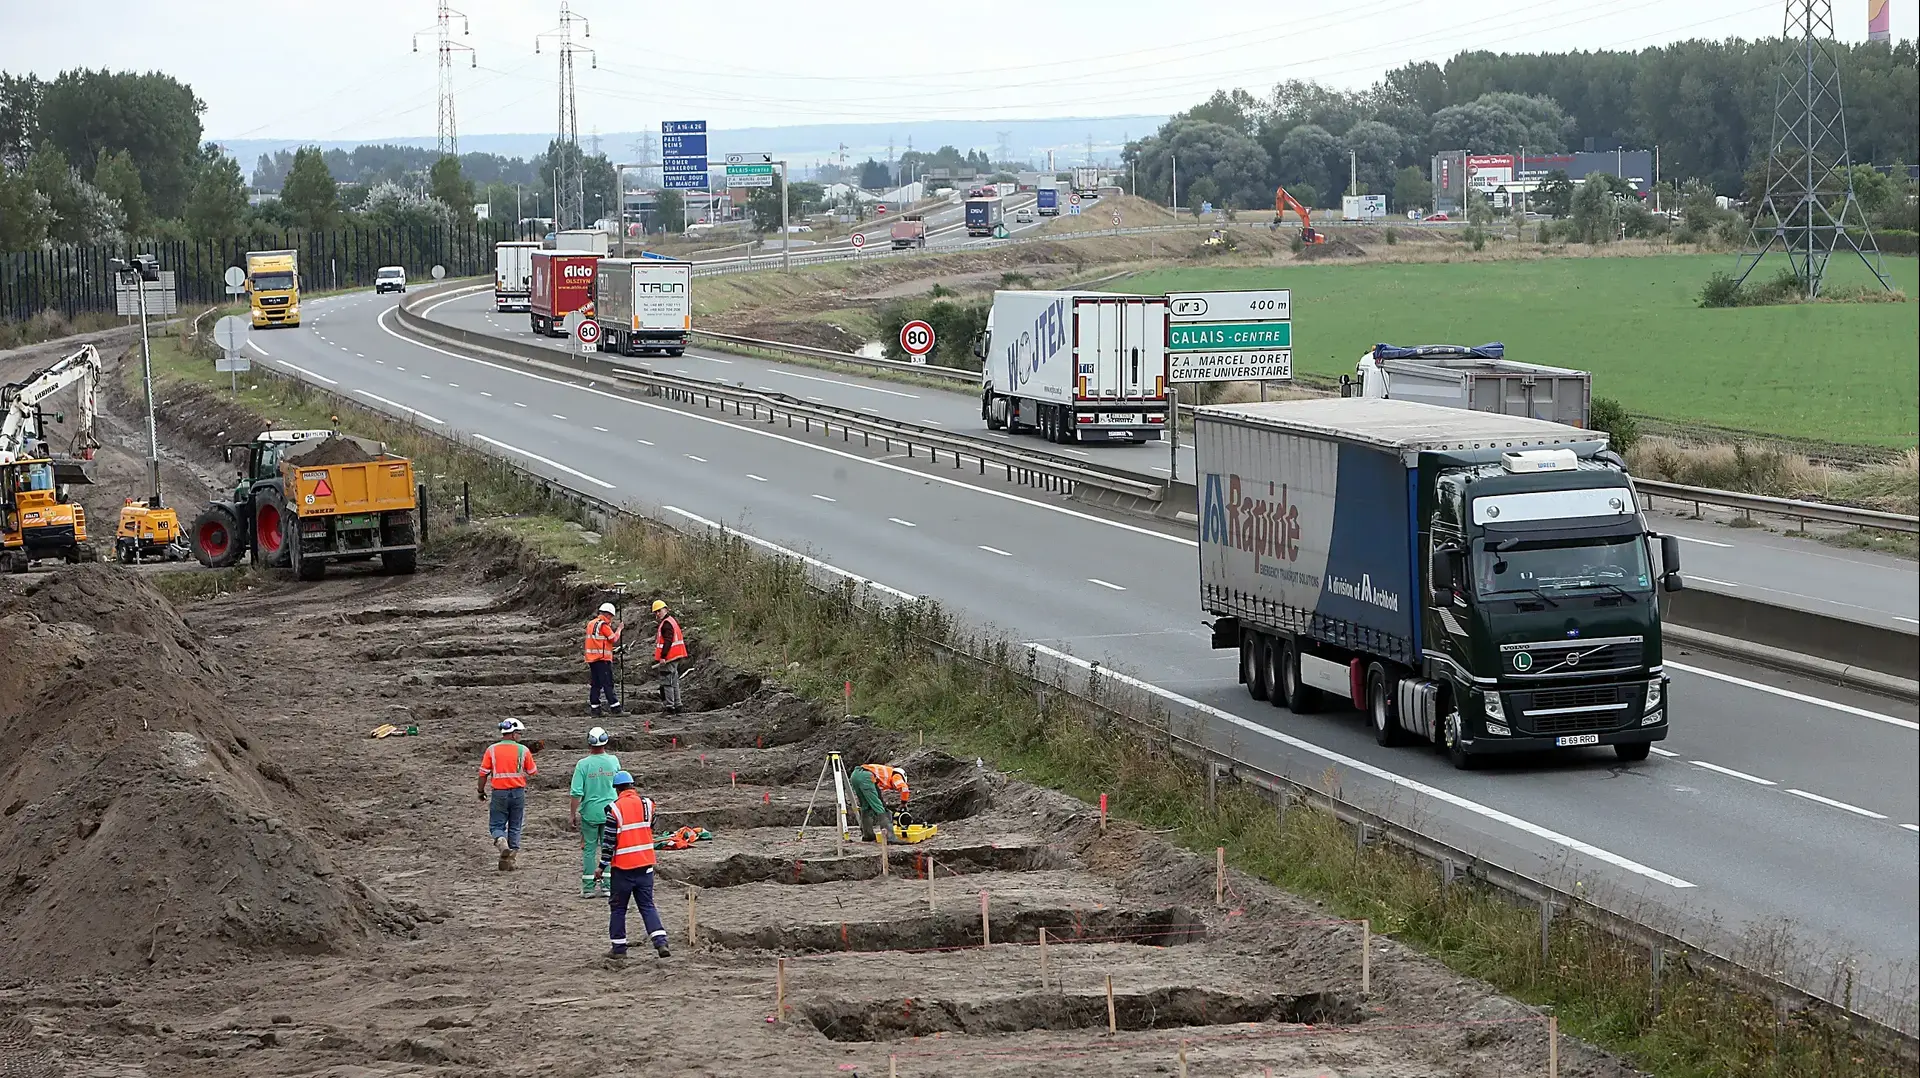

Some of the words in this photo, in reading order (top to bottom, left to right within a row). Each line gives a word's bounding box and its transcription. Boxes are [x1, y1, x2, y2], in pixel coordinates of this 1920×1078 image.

[564, 265, 592, 278] Aldo
[639, 282, 684, 293] TRON
[1193, 302, 1200, 312] 3
[1249, 300, 1274, 310] 400
[582, 327, 596, 337] 80
[908, 331, 927, 344] 80
[1007, 297, 1066, 392] WOJTEX
[1198, 355, 1245, 366] MARCEL
[1250, 353, 1289, 364] DORET
[1080, 364, 1094, 373] TIR
[1172, 368, 1211, 379] CENTRE
[1213, 366, 1289, 378] UNIVERSITAIRE
[1225, 473, 1300, 574] Rapide
[1260, 563, 1279, 580] EMERGENCY
[1299, 572, 1320, 588] SOLUTIONS
[1332, 576, 1354, 598] division
[1354, 582, 1360, 601] of
[1372, 586, 1398, 612] Archbold
[1518, 655, 1527, 668] L
[1561, 737, 1567, 745] B
[1569, 736, 1578, 745] 69
